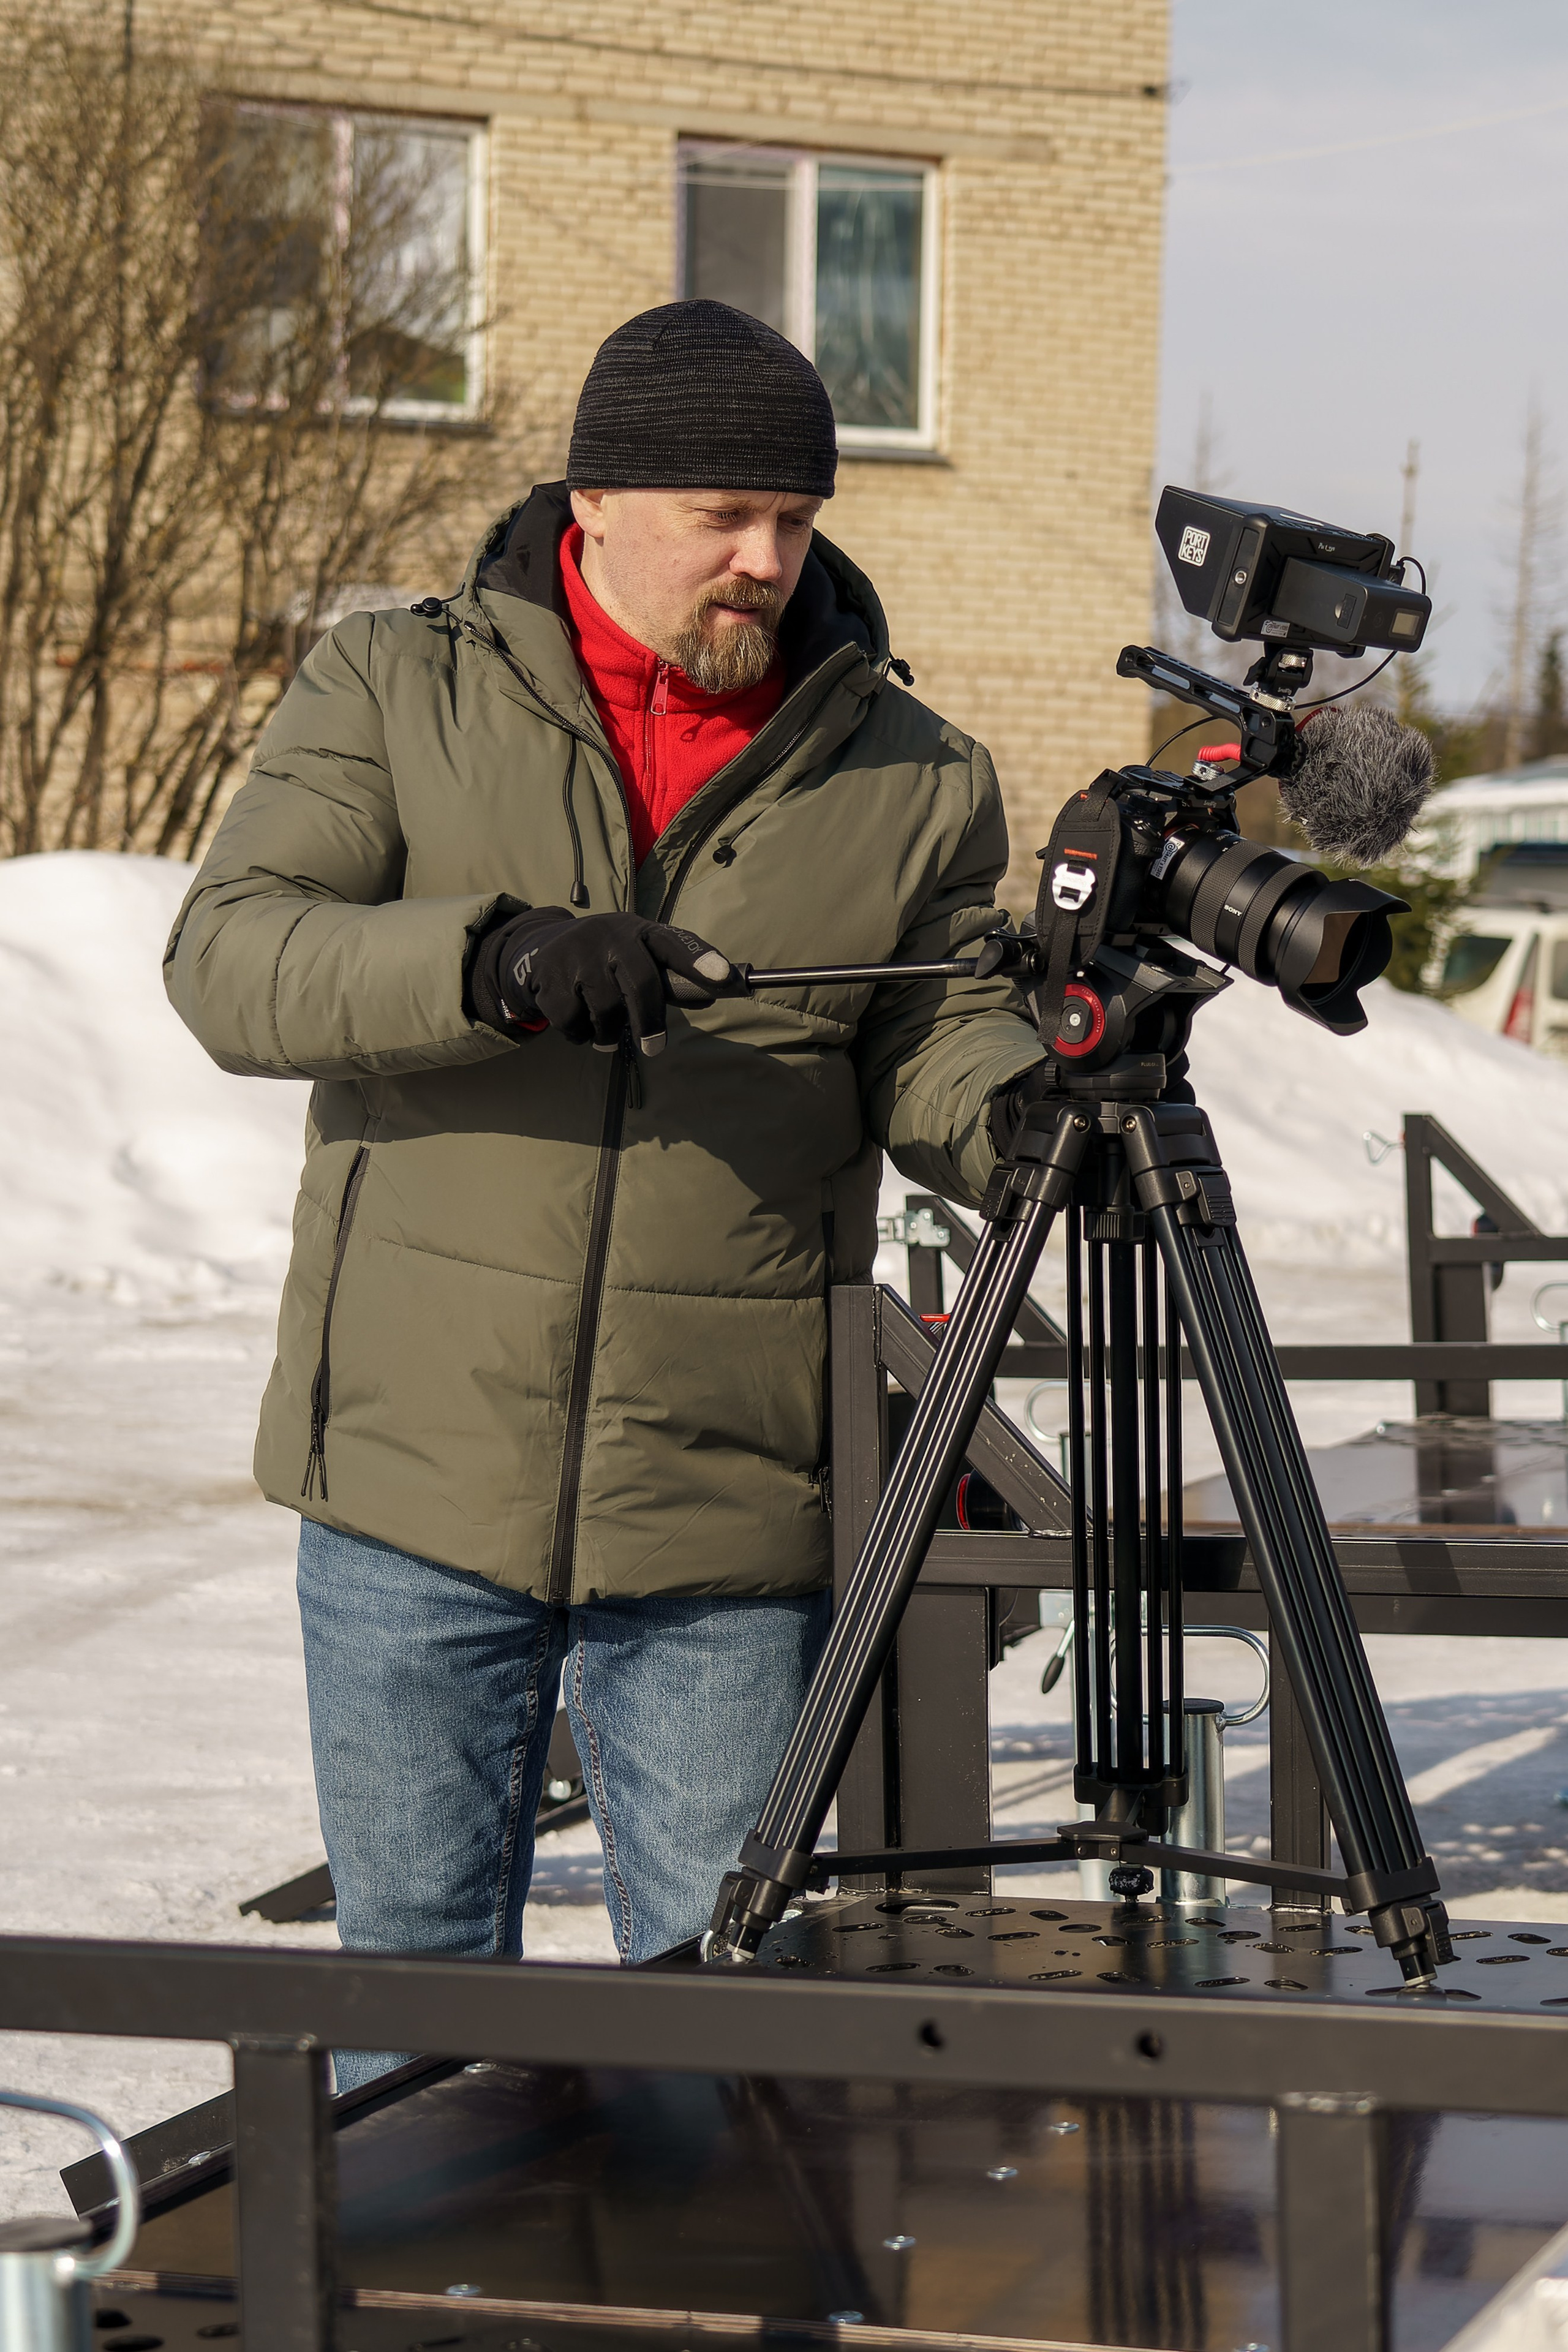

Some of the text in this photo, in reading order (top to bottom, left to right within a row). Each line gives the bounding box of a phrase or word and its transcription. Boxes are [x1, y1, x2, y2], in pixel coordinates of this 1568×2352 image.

[1185, 530, 1207, 549] PORT
[1181, 543, 1204, 563] KEYS
[1224, 904, 1242, 916] SONY
